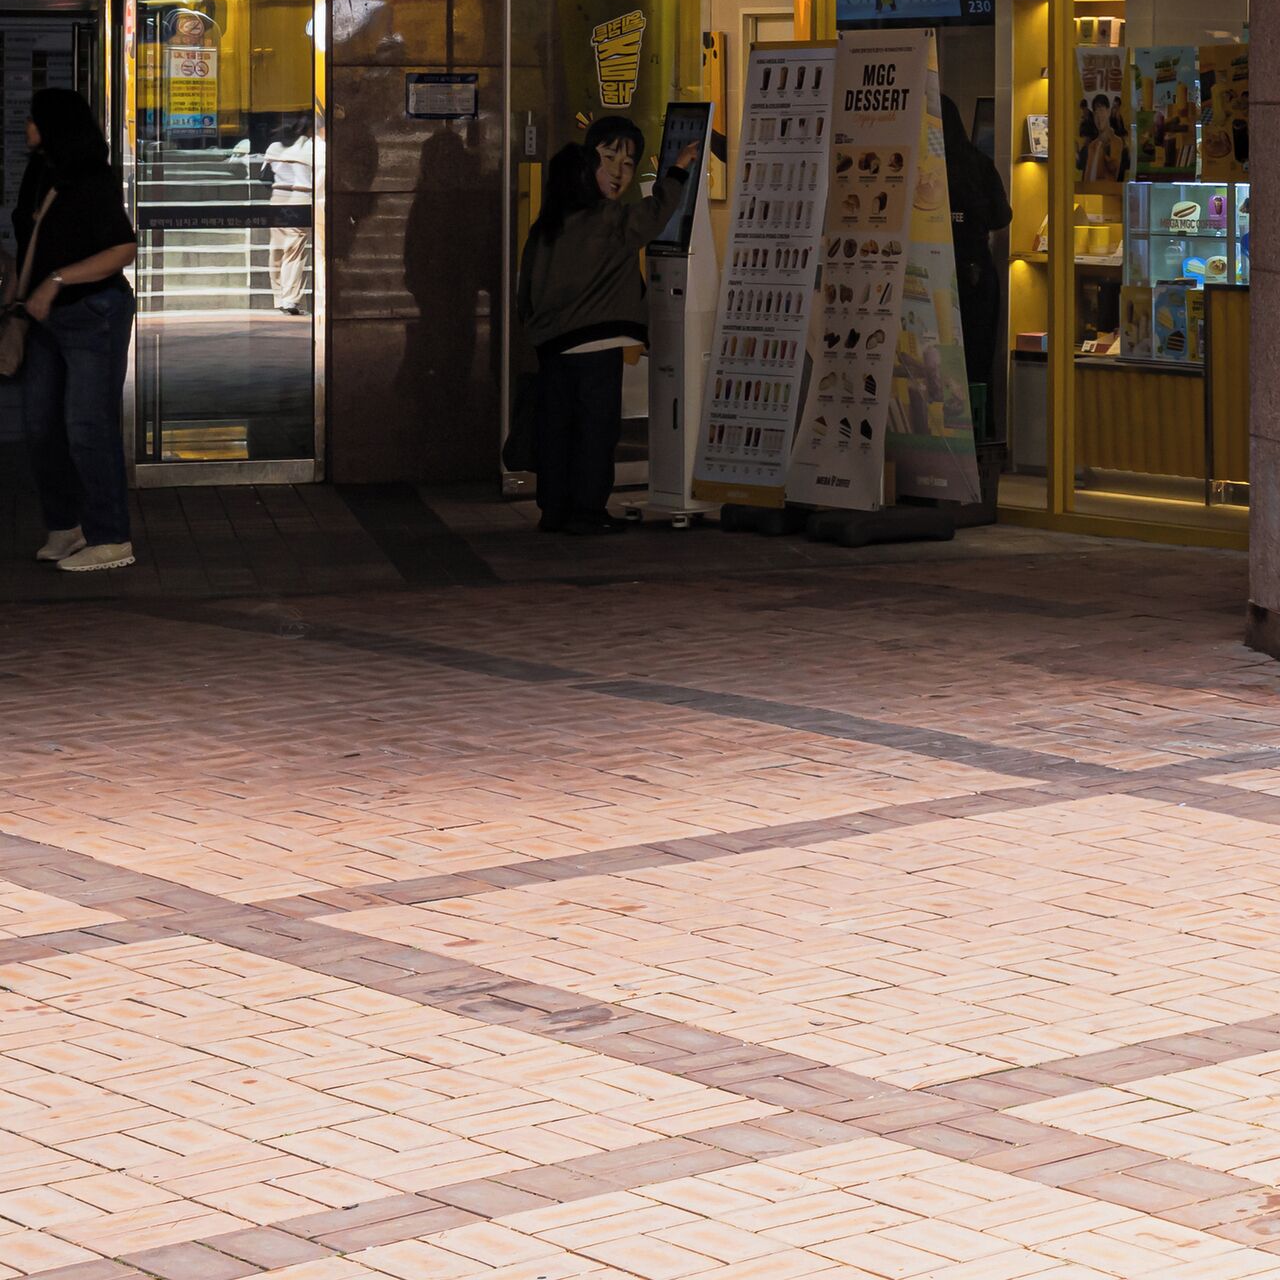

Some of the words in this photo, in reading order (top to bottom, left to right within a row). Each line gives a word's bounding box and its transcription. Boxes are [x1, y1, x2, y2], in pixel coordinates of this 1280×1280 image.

[968, 0, 992, 13] 230
[863, 63, 896, 87] MGC
[844, 88, 910, 112] DESSERT
